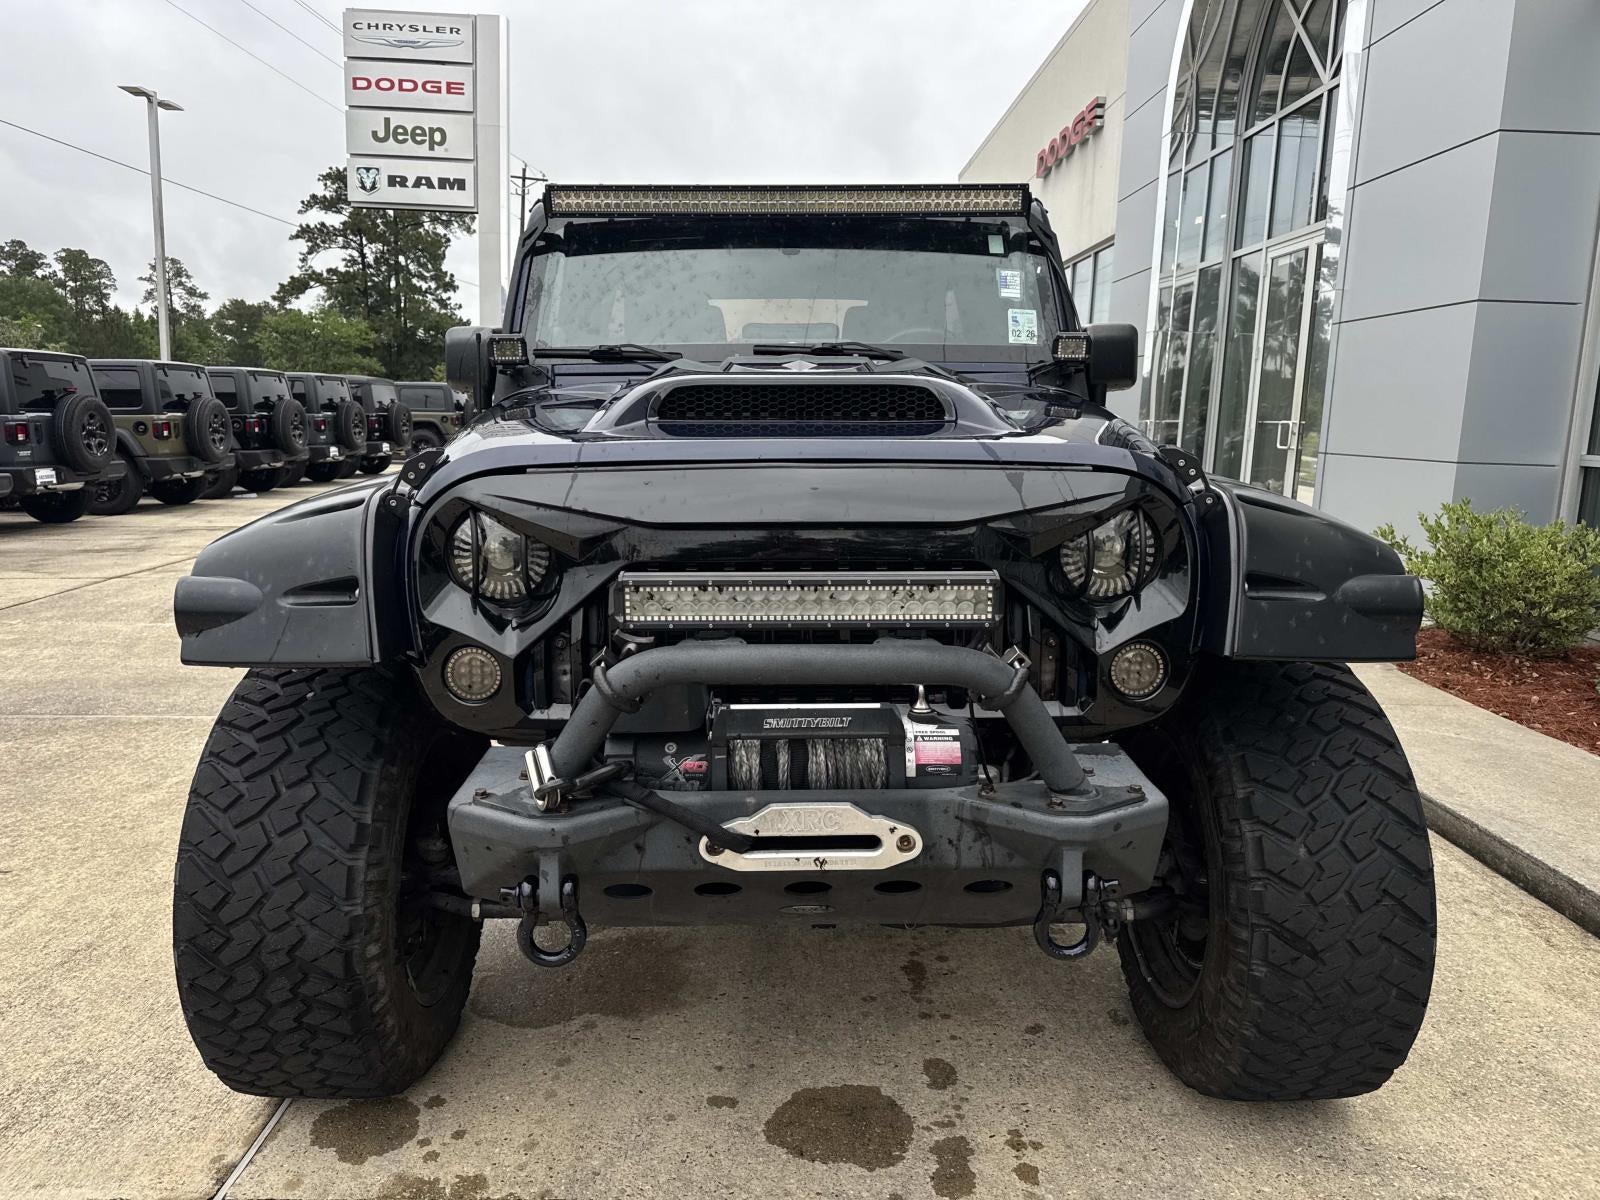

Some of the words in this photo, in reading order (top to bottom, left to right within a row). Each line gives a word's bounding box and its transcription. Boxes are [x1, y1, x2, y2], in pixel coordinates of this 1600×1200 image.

[352, 22, 462, 35] CHRYSLER
[351, 76, 465, 96] DODGE
[371, 117, 447, 151] Jeep
[1036, 96, 1106, 178] DODGE
[387, 174, 466, 191] RAM
[1011, 329, 1022, 338] 02
[1026, 330, 1036, 338] 26
[763, 717, 852, 728] SMITTYBILT
[782, 808, 842, 833] XRC
